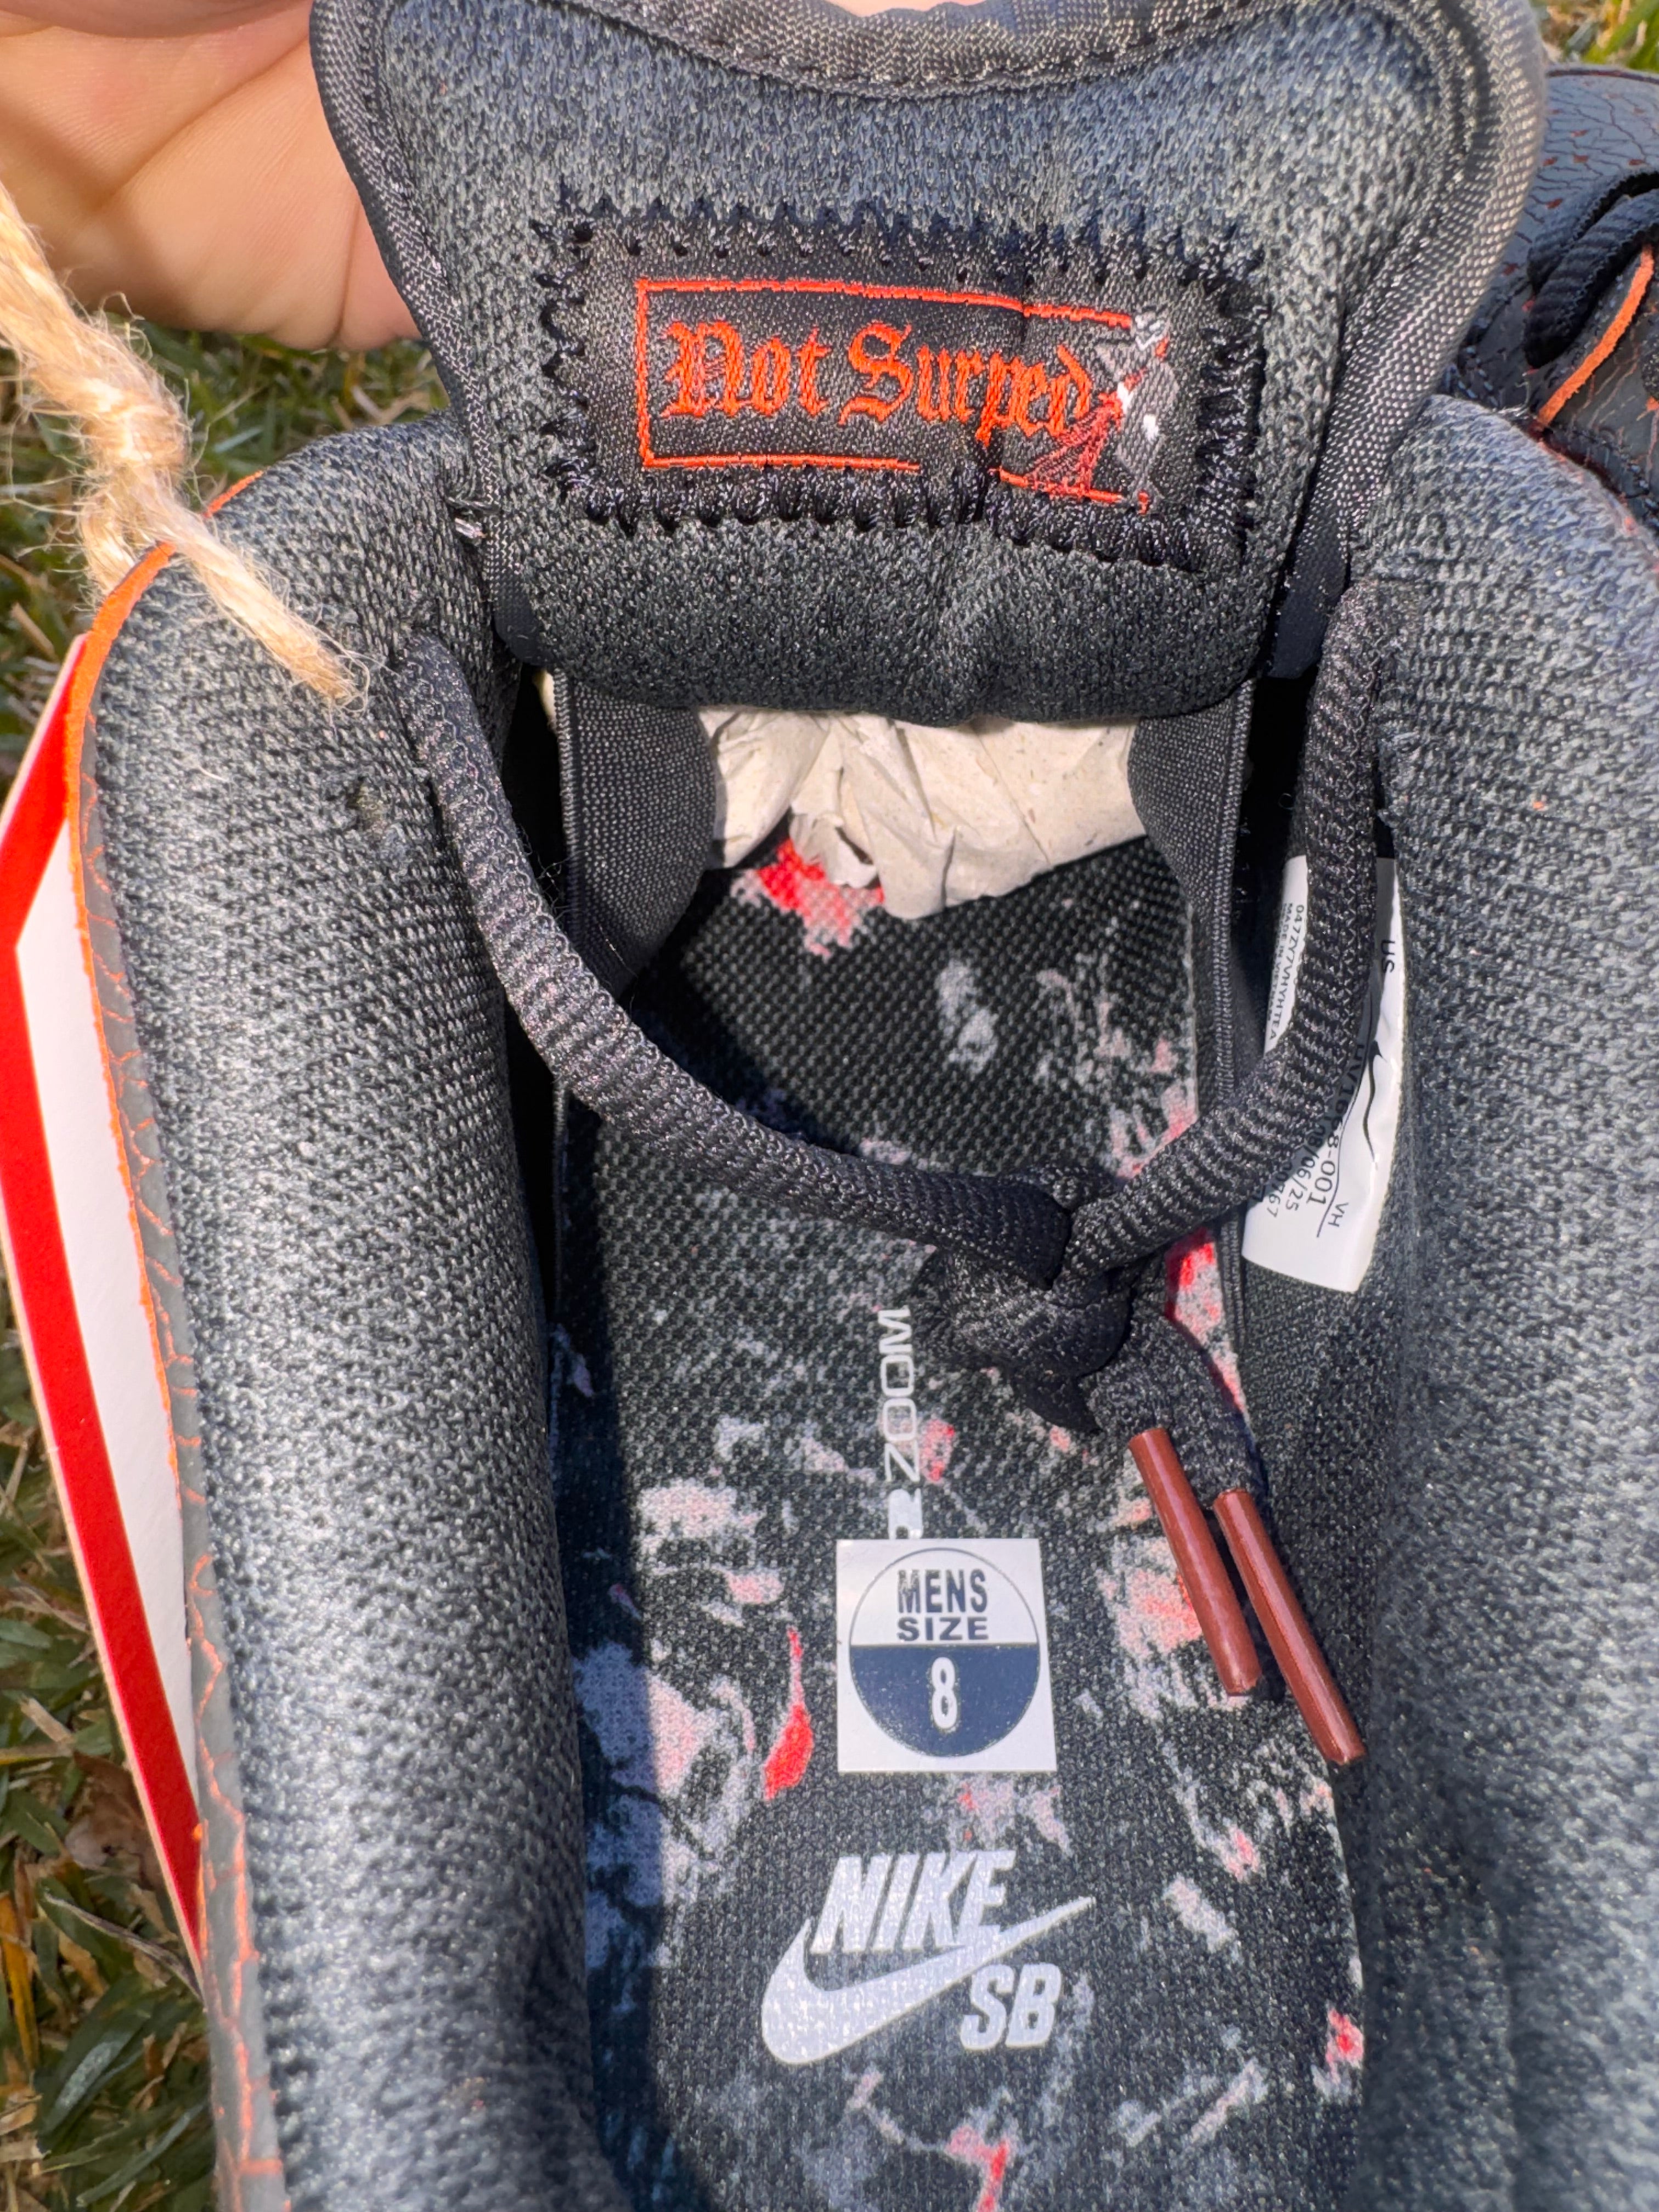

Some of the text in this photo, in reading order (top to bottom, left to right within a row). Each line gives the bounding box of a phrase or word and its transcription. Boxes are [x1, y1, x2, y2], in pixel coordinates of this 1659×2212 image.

[660, 320, 831, 417] Not
[1381, 939, 1396, 973] US
[1328, 1202, 1350, 1227] VH
[878, 1305, 921, 1482] ZOOM
[897, 1569, 988, 1613] MENS
[896, 1616, 989, 1641] SIZE
[931, 1656, 958, 1730] 8
[810, 1850, 1017, 1954] NIKE
[960, 1963, 1062, 2051] SB
